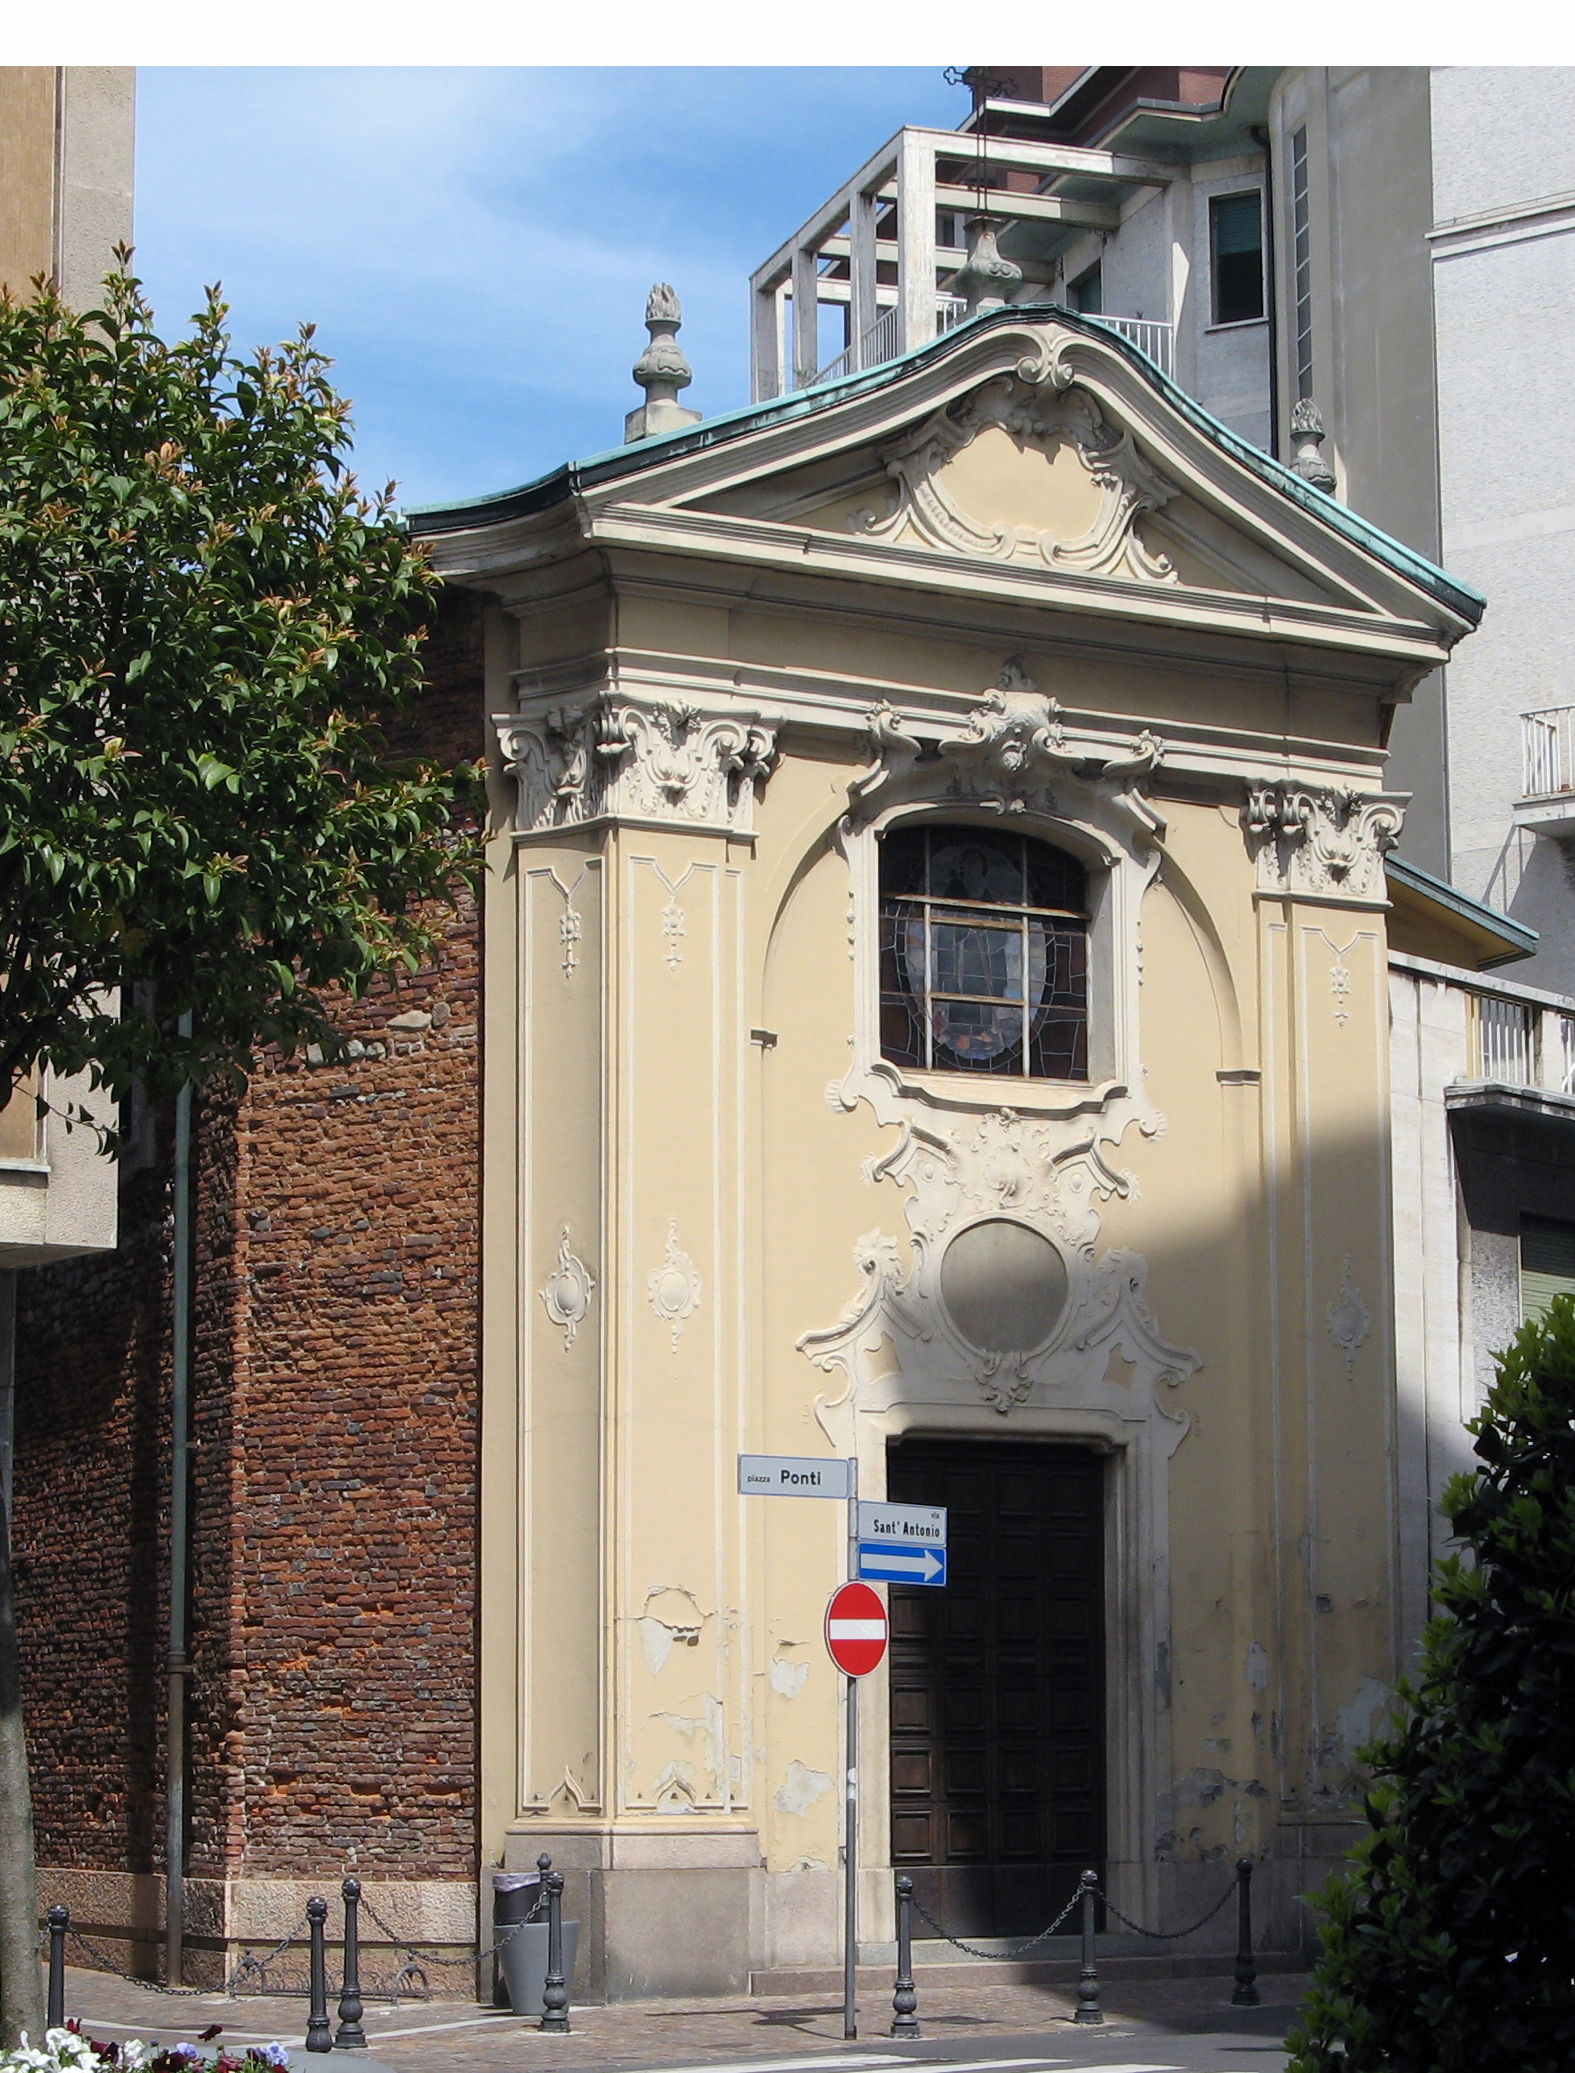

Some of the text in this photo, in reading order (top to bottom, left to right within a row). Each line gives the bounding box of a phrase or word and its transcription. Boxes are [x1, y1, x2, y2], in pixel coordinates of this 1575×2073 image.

[747, 1470, 821, 1485] piazza Ponti
[873, 1519, 940, 1538] Sant' Antonio
